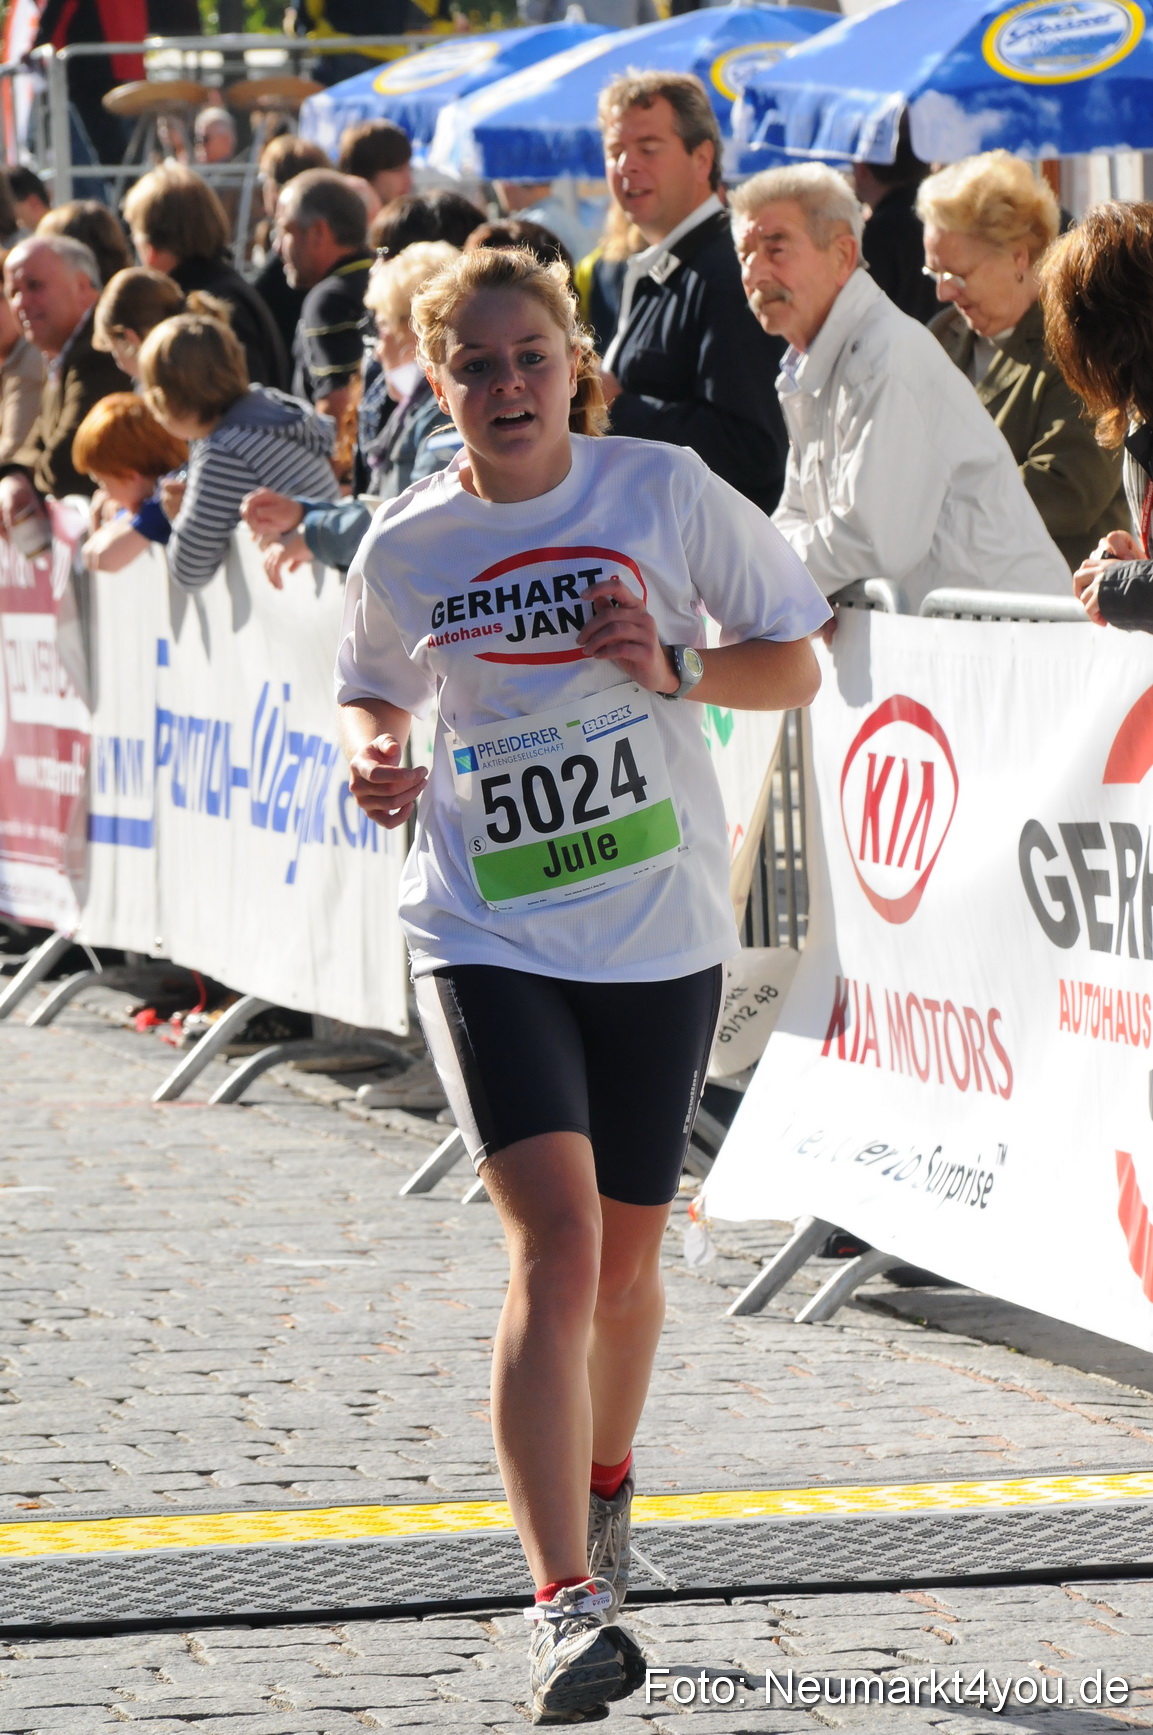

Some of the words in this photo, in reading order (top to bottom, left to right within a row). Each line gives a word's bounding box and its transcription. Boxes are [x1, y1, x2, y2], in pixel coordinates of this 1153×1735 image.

[431, 567, 603, 630] GERHART
[427, 622, 503, 648] Autohaus
[505, 601, 599, 643] JÄN
[581, 704, 633, 735] BOCK
[477, 726, 562, 760] PFLEIDERER
[482, 742, 565, 770] AKTIENGESELLSCHAFT
[480, 737, 648, 844] 5024
[859, 753, 934, 871] KIA
[543, 831, 619, 878] Jule
[754, 984, 779, 1005] 48
[1058, 978, 1152, 1050] AUTOHAUS
[821, 975, 881, 1069] KIA
[885, 988, 1014, 1101] MOTORS
